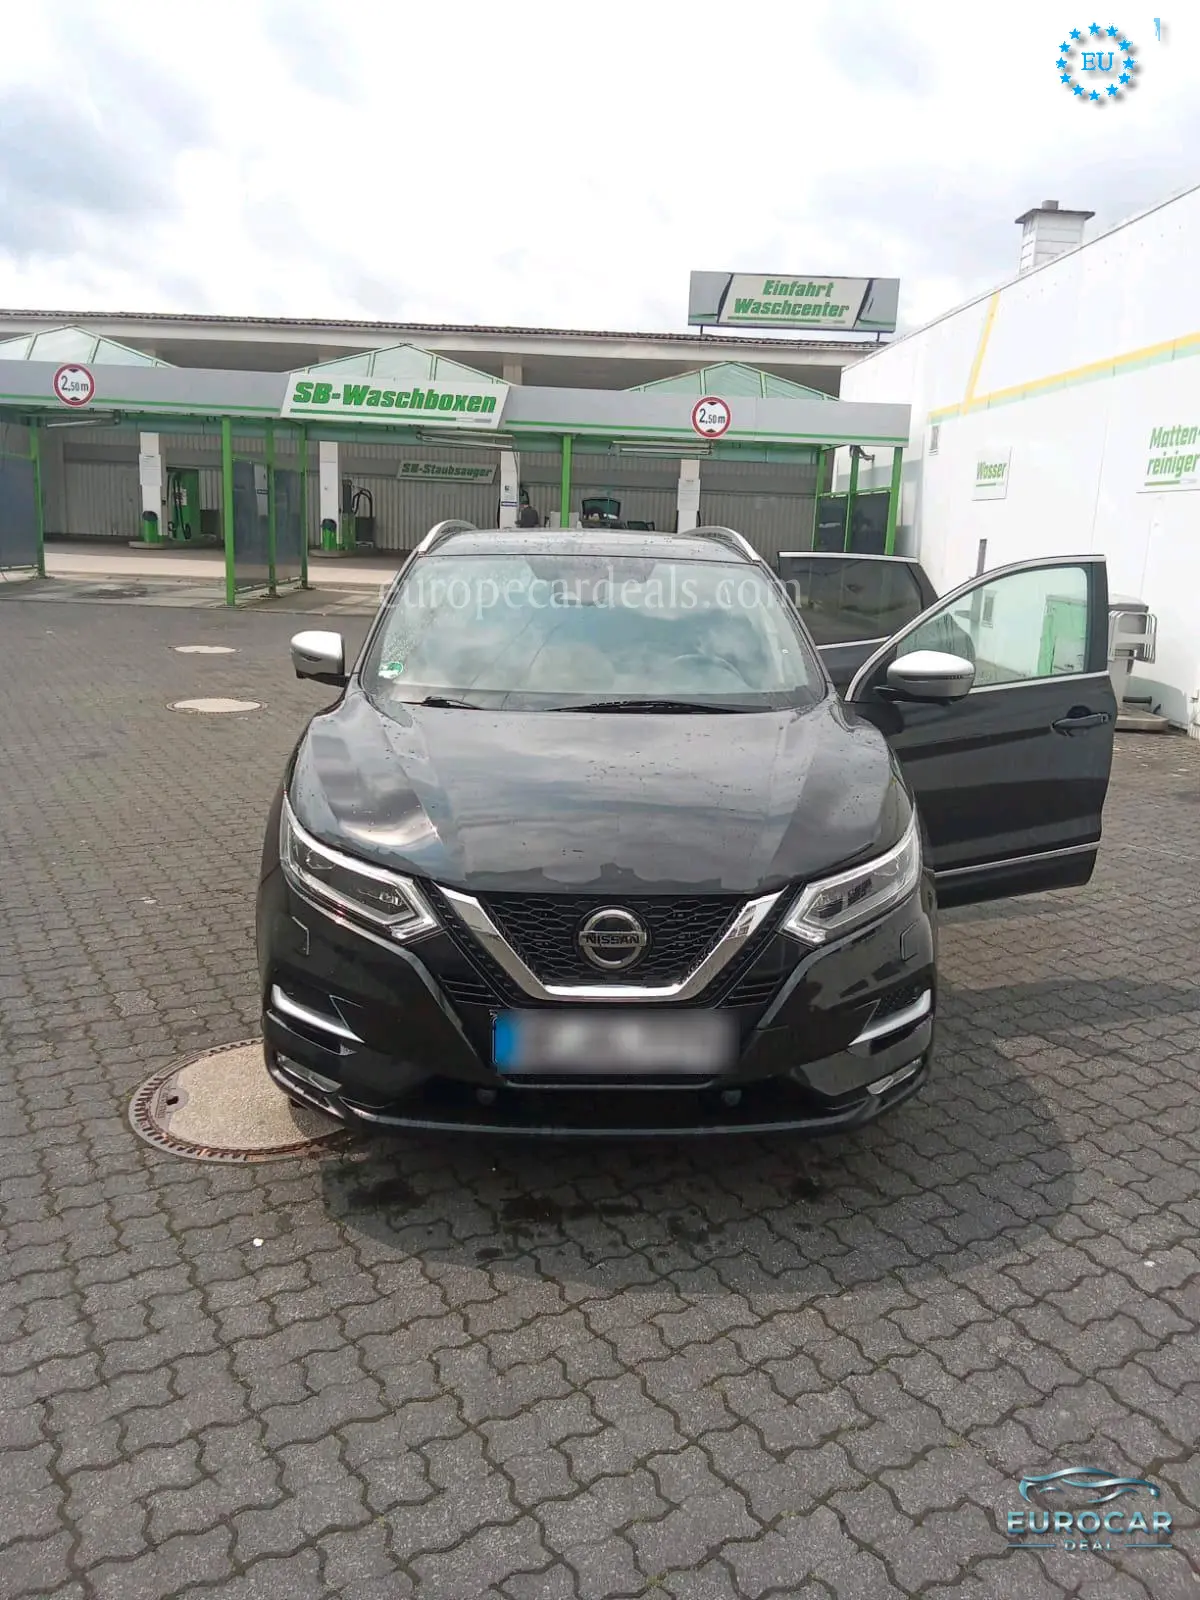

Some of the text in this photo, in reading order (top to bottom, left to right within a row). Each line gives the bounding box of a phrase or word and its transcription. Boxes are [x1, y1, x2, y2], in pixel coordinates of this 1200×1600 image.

[762, 279, 834, 297] Einfahrt
[734, 298, 849, 317] Waschcenter
[292, 381, 497, 413] SB-Waschboxen
[1146, 450, 1200, 478] reiniger
[585, 933, 640, 945] NISSAN
